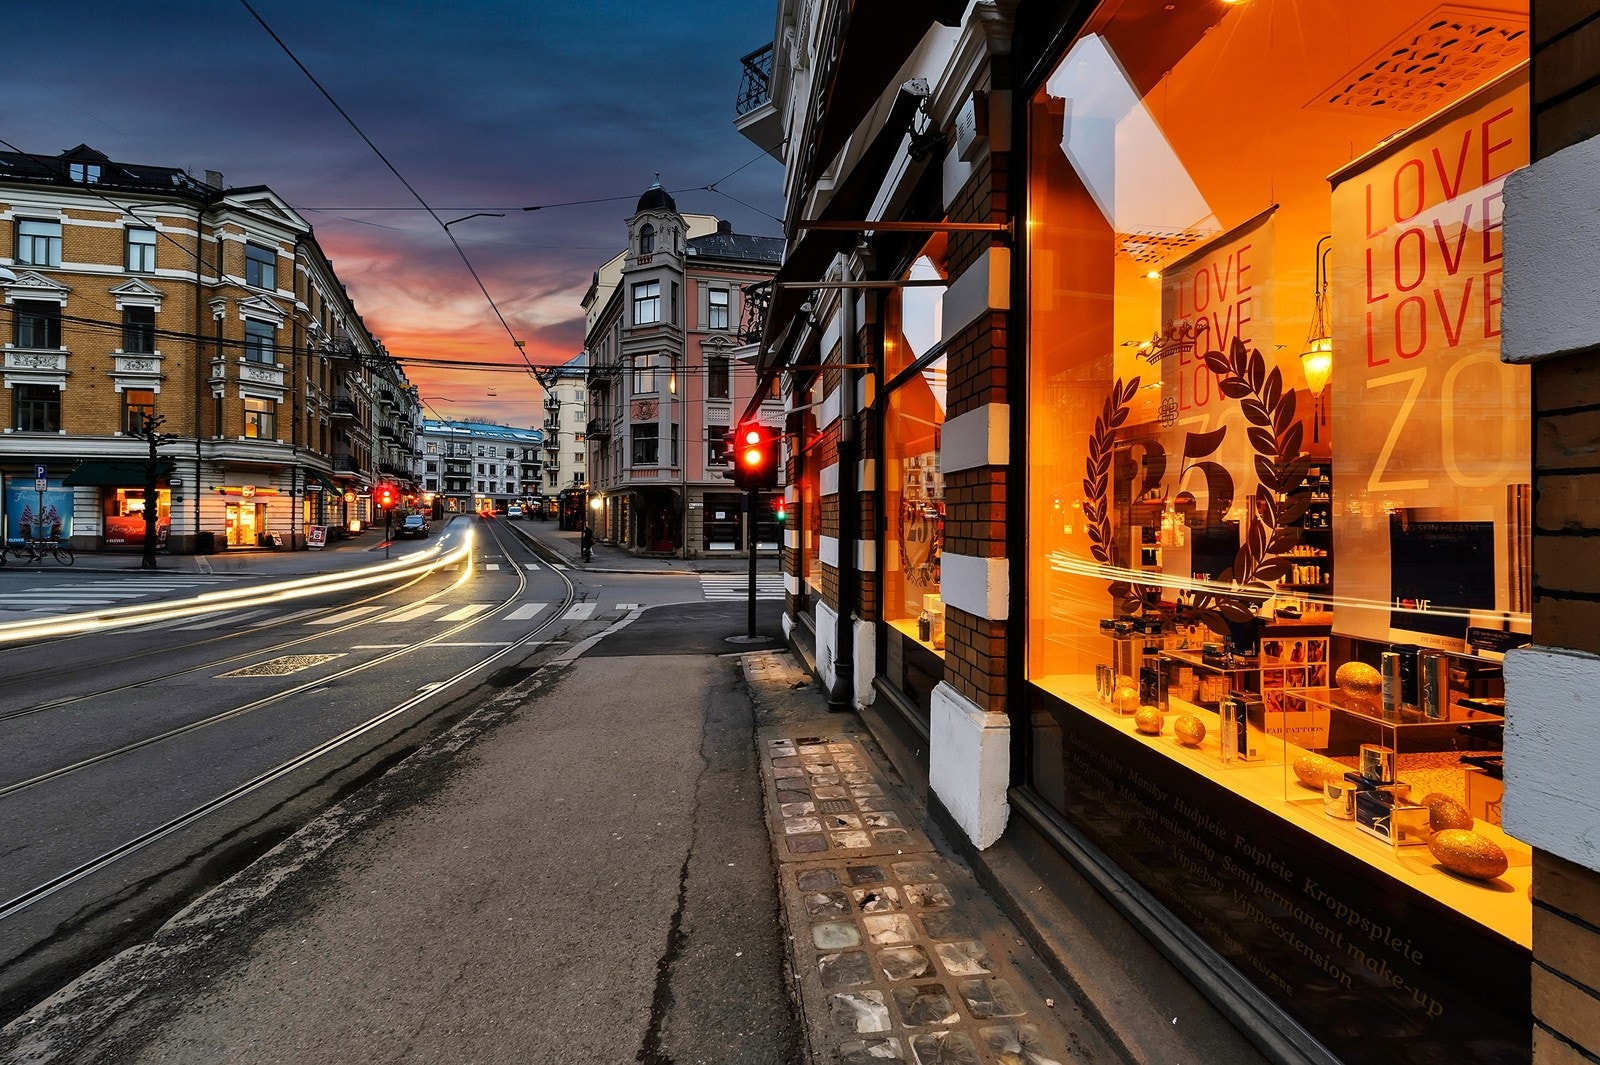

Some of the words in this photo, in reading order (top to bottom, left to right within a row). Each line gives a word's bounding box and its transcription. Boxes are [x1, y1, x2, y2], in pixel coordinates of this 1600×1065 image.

[1366, 107, 1514, 240] LOVE
[1178, 244, 1252, 320] LOVE
[1366, 190, 1504, 305] LOVE
[1179, 297, 1252, 367] LOVE
[37, 466, 45, 478] P
[1366, 352, 1516, 492] ZO
[1126, 425, 1235, 529] 25
[1284, 726, 1324, 734] TATTOOS
[1126, 767, 1169, 806] Manikyr
[1173, 796, 1227, 840] Hudpleie
[1233, 833, 1294, 882] Fotpleie
[1303, 876, 1425, 966] Kroppspleie
[1171, 845, 1225, 894] Vippebøy
[1231, 888, 1355, 991] Vippeextension
[1222, 854, 1345, 949] Semipermanent
[1347, 941, 1445, 1019] make-up
[1248, 952, 1294, 998] VELVÆRE
